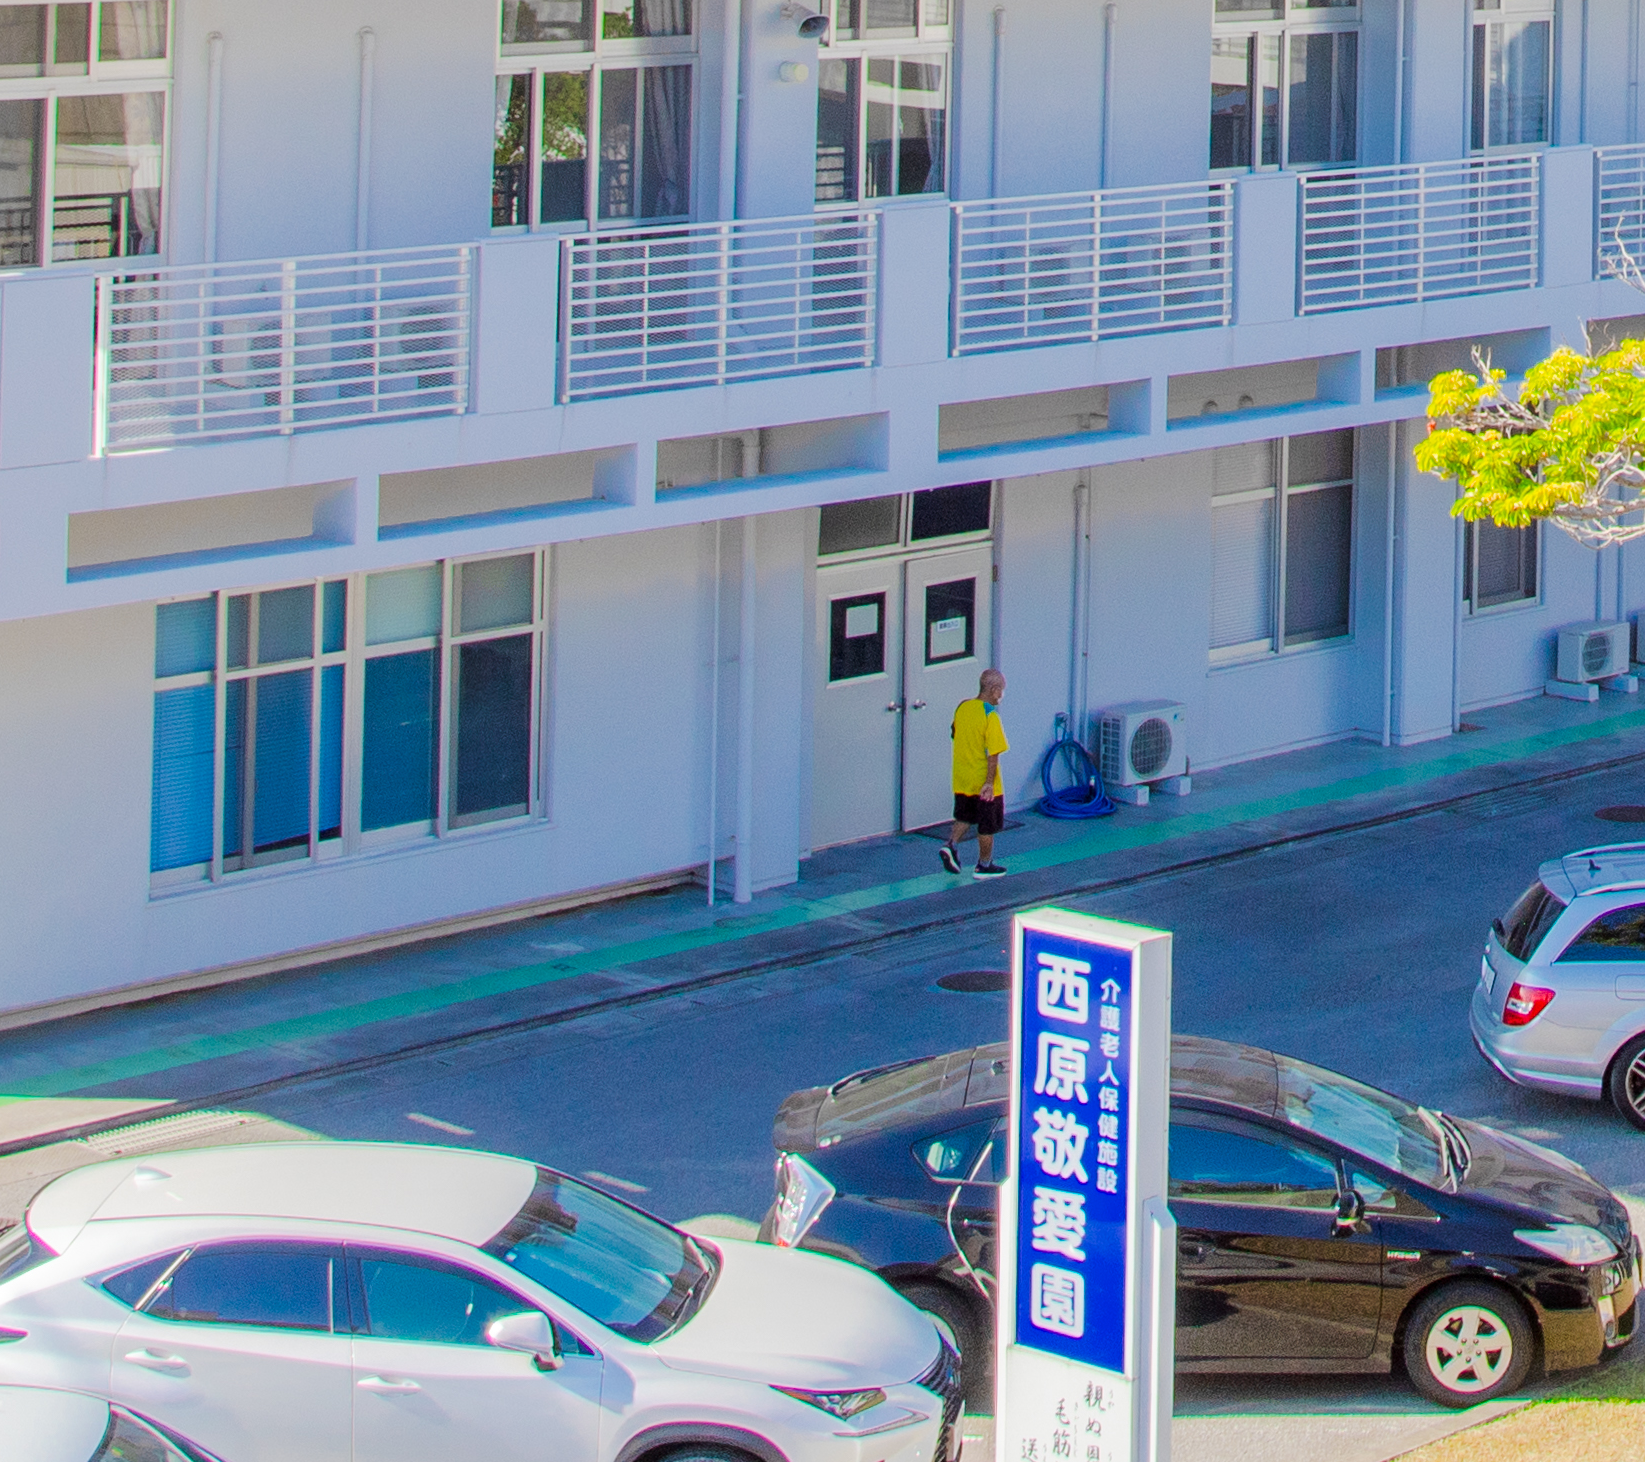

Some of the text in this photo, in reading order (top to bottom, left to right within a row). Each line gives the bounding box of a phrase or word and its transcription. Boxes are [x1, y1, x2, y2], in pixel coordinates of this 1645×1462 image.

[1030, 952, 1092, 1339] 西原敬愛園
[1095, 978, 1122, 1195] 介護老人保健施設
